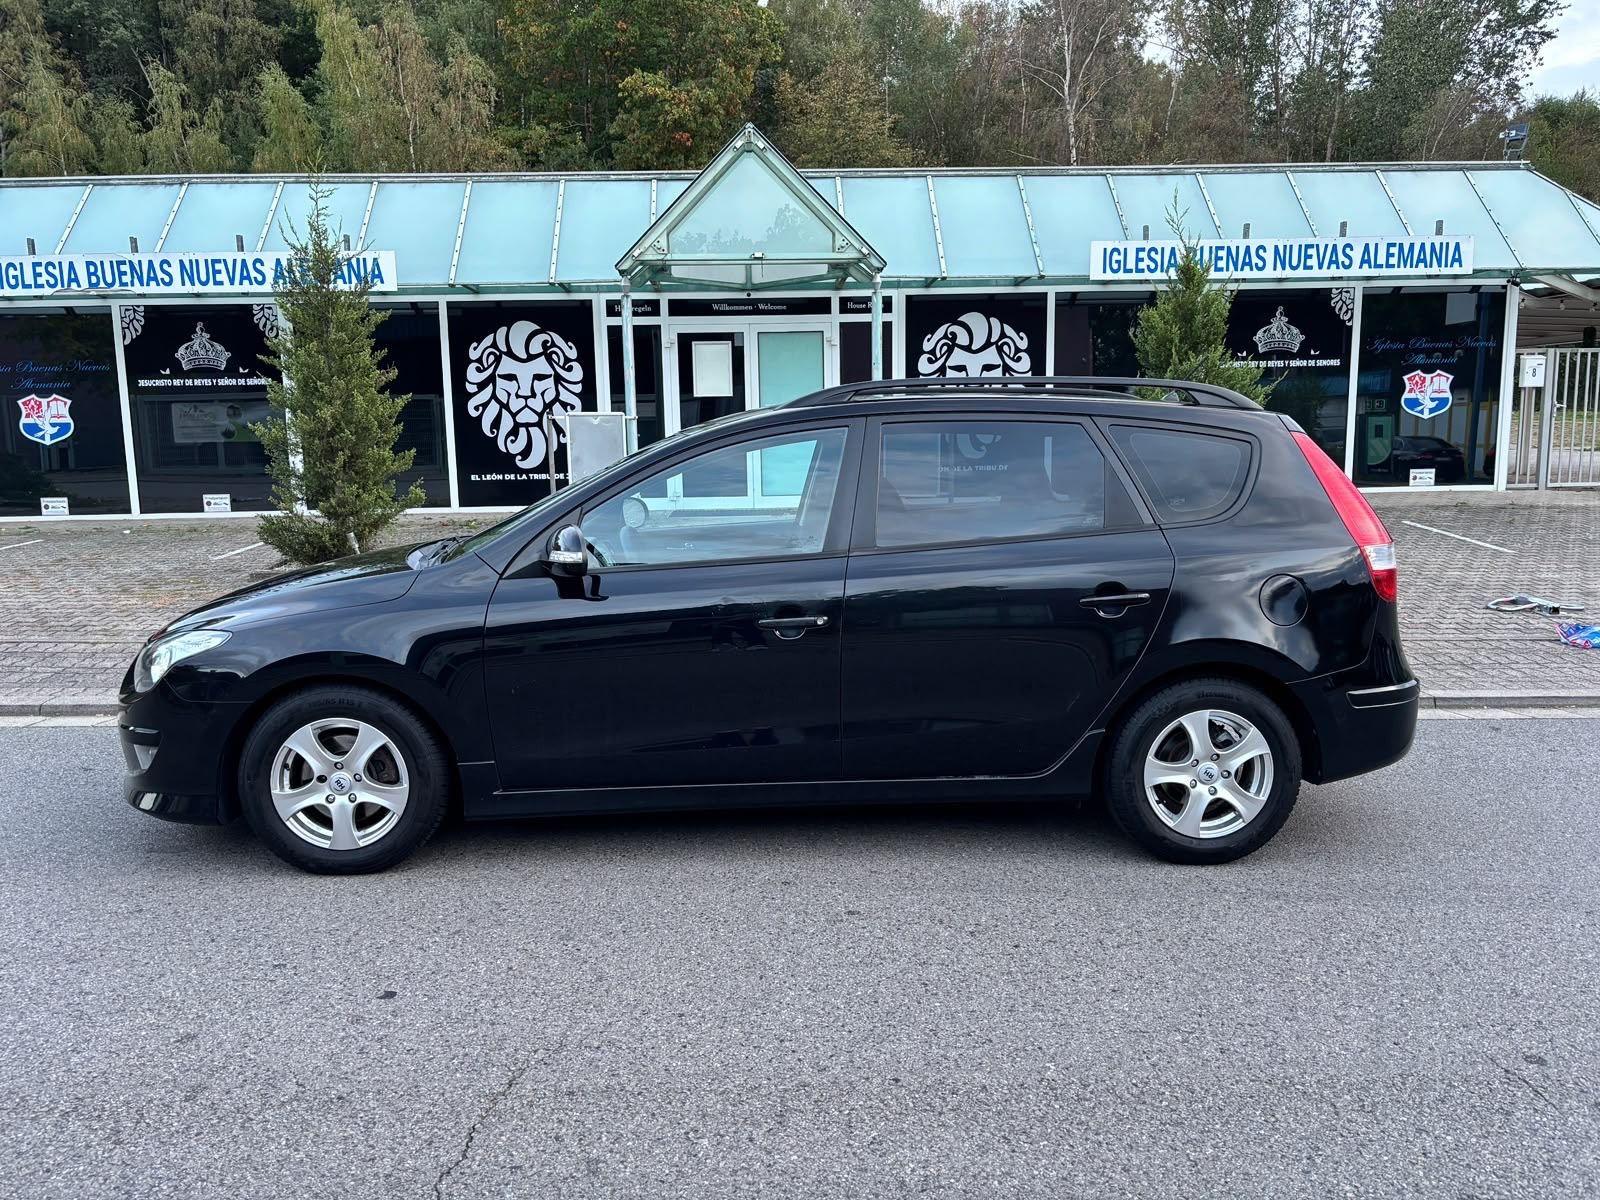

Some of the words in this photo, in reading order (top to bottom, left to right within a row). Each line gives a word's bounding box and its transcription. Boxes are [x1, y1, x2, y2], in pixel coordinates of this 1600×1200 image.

[1102, 246, 1179, 274] IGLESIA
[1273, 243, 1354, 271] NUEVAS
[1358, 241, 1463, 270] ALEMANIA
[0, 260, 82, 290] IGLESIA
[85, 258, 174, 289] BUENAS
[178, 257, 267, 287] NUEVAS
[272, 256, 385, 286] AANIA
[614, 303, 652, 313] Hregeln
[712, 303, 753, 311] Willkommen
[758, 302, 788, 310] Welcome
[847, 301, 867, 309] House
[1290, 358, 1307, 367] SEÑOR
[1532, 368, 1537, 378] 8
[138, 379, 172, 387] JESUCRISTO
[218, 376, 237, 386] SEÑOR
[482, 472, 503, 481] LEÓN
[334, 778, 346, 791] RH
